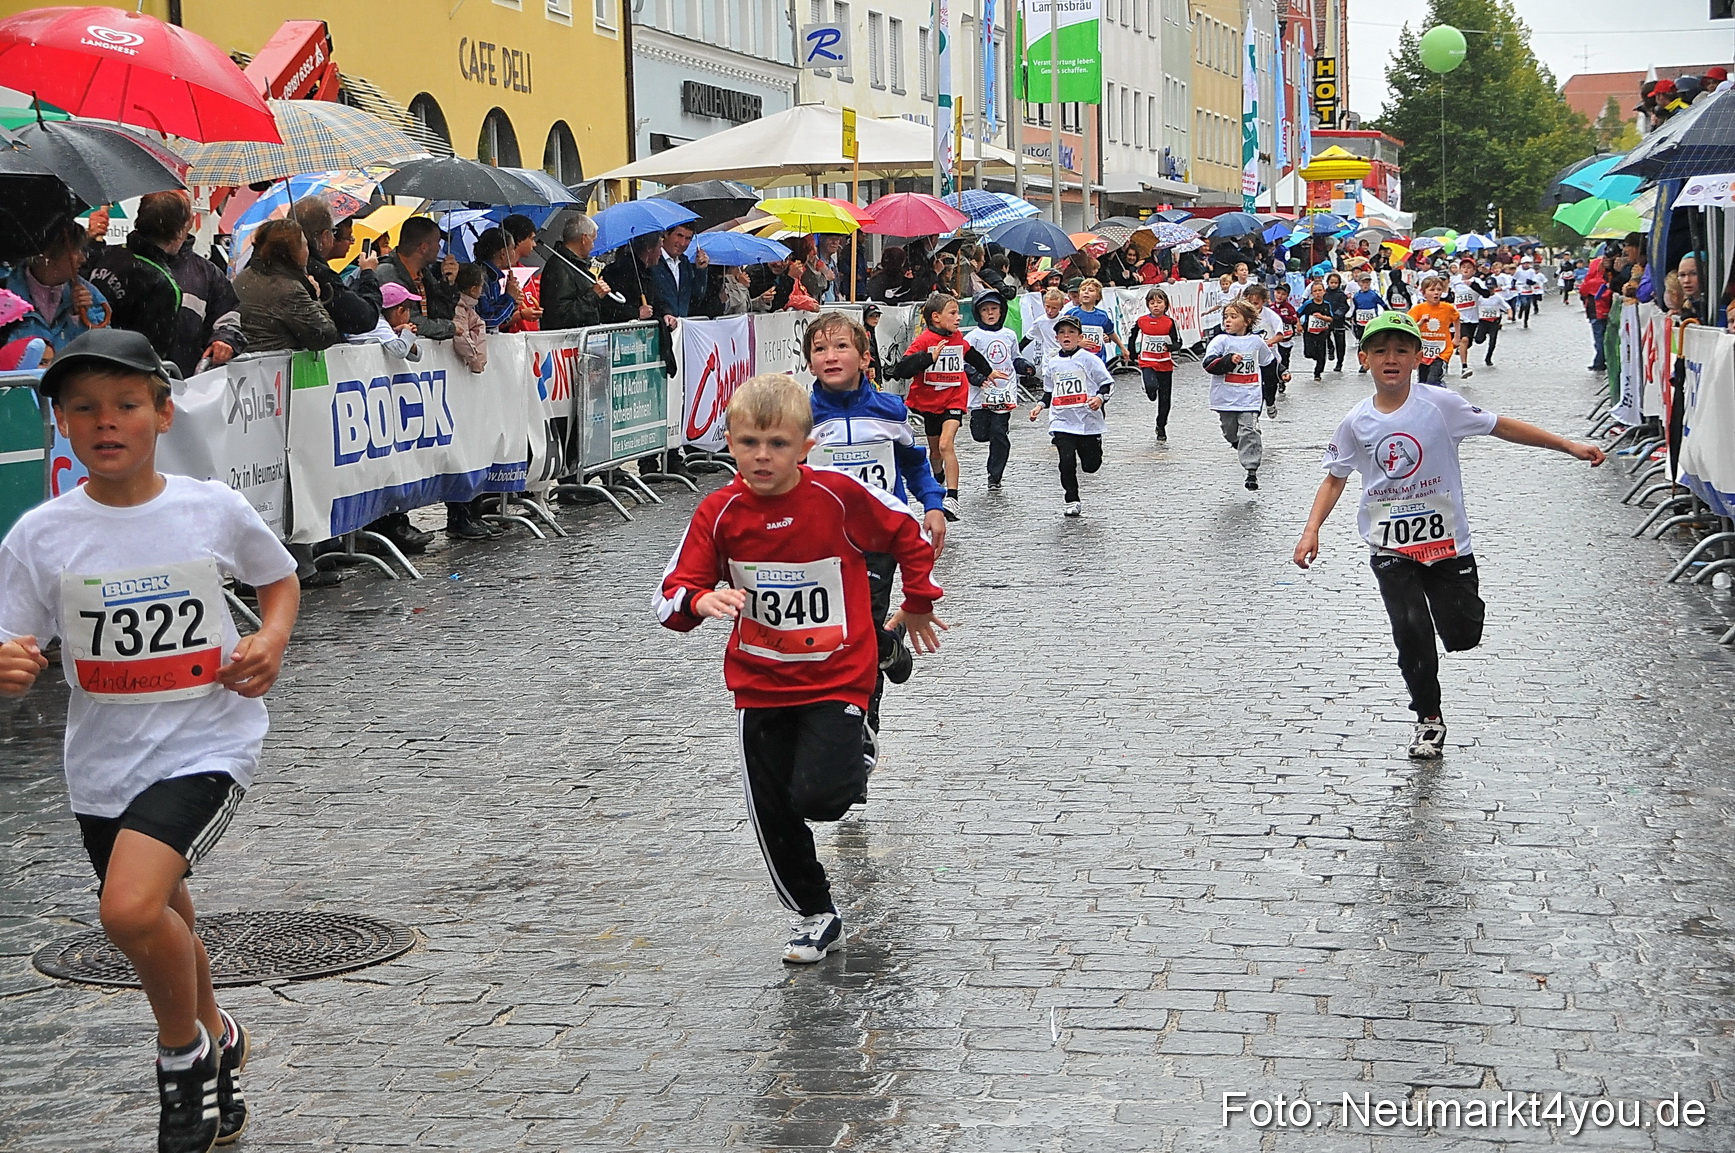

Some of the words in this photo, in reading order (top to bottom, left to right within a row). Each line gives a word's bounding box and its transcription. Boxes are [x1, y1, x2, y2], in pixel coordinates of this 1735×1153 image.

[80, 38, 136, 56] LANGNESE
[806, 28, 843, 62] R.
[459, 37, 497, 85] CAFE
[502, 47, 531, 94] DELI
[690, 82, 729, 119] BRILLEN
[730, 90, 763, 123] WEBER
[1315, 60, 1336, 122] HOT
[764, 338, 792, 363] RECHTS
[1055, 379, 1083, 397] 7120
[332, 370, 455, 467] BOCK
[833, 451, 870, 461] BOCK
[230, 467, 242, 490] 2x
[242, 464, 251, 488] in
[1401, 484, 1417, 493] MIT
[1420, 476, 1442, 488] HERZ
[1390, 503, 1426, 514] BOCK
[766, 518, 791, 530] JAKO
[1378, 513, 1445, 547] 7028
[102, 574, 170, 598] BOCK
[756, 570, 806, 582] BOCK
[79, 598, 208, 658] 7322
[86, 666, 177, 692] Andreas
